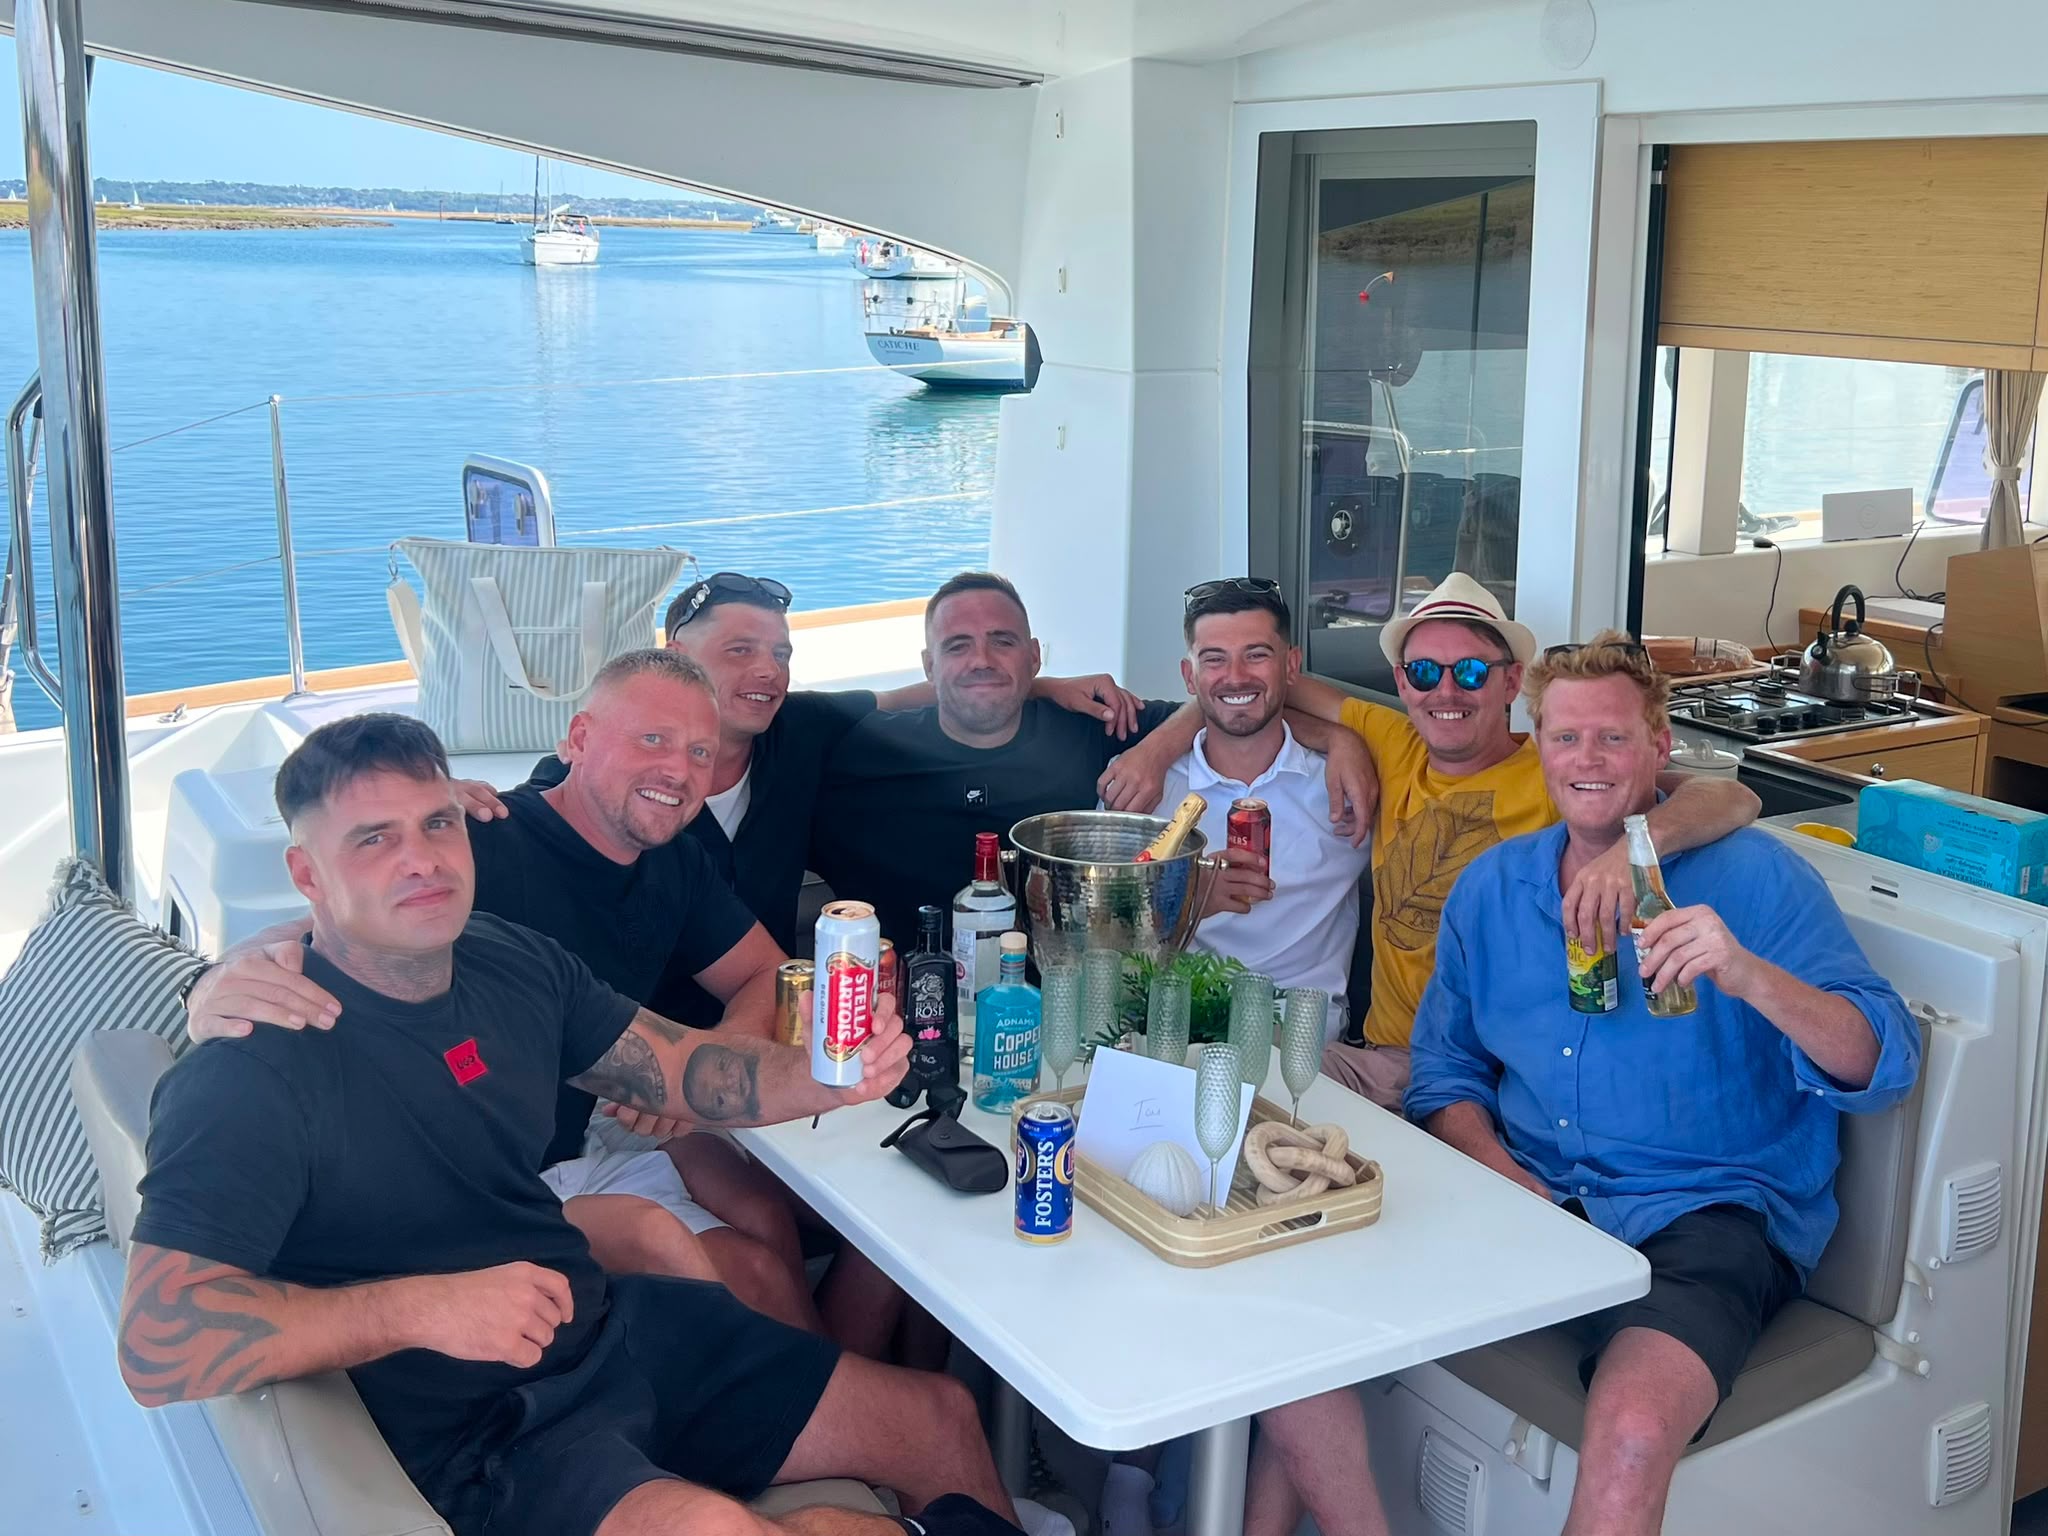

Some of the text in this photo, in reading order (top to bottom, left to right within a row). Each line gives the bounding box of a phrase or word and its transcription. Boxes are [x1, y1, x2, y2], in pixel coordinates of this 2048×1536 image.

[837, 974, 853, 1042] ARTOIS
[853, 973, 867, 1039] STELLA
[915, 1006, 945, 1018] ROSE
[993, 1047, 1034, 1070] HOUSE
